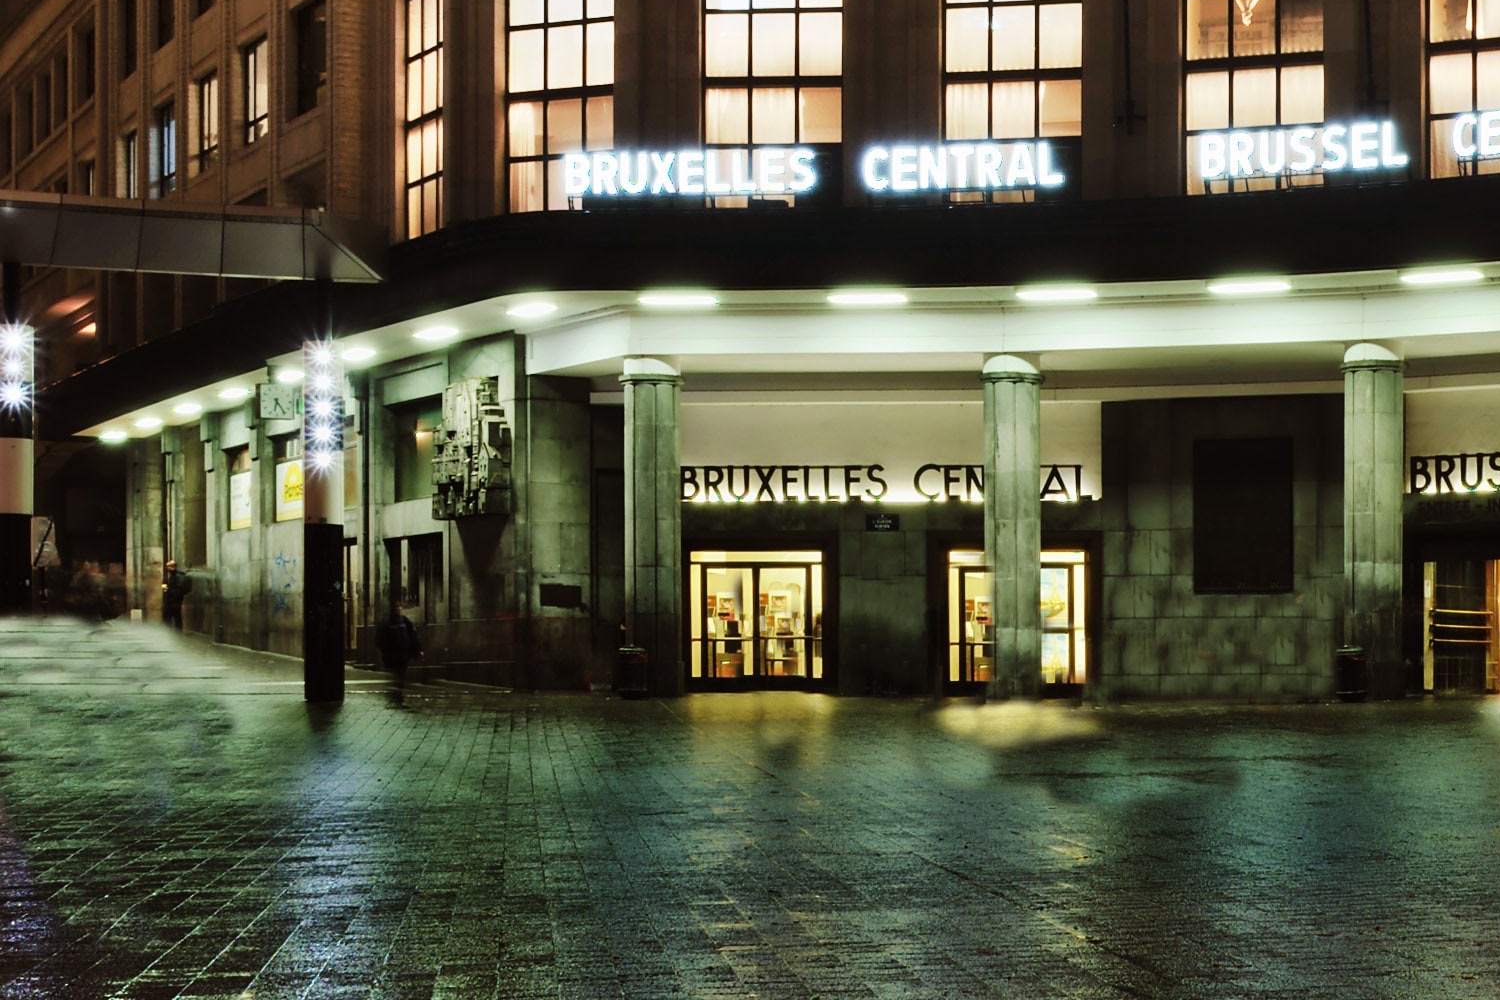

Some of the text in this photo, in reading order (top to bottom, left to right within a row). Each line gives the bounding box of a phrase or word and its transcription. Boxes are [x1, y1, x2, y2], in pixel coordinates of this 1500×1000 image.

[564, 142, 1065, 195] BRUXELLES CENTRAL
[1200, 121, 1408, 177] BRUSSEL
[680, 463, 1093, 501] BRUXELLES CENAL
